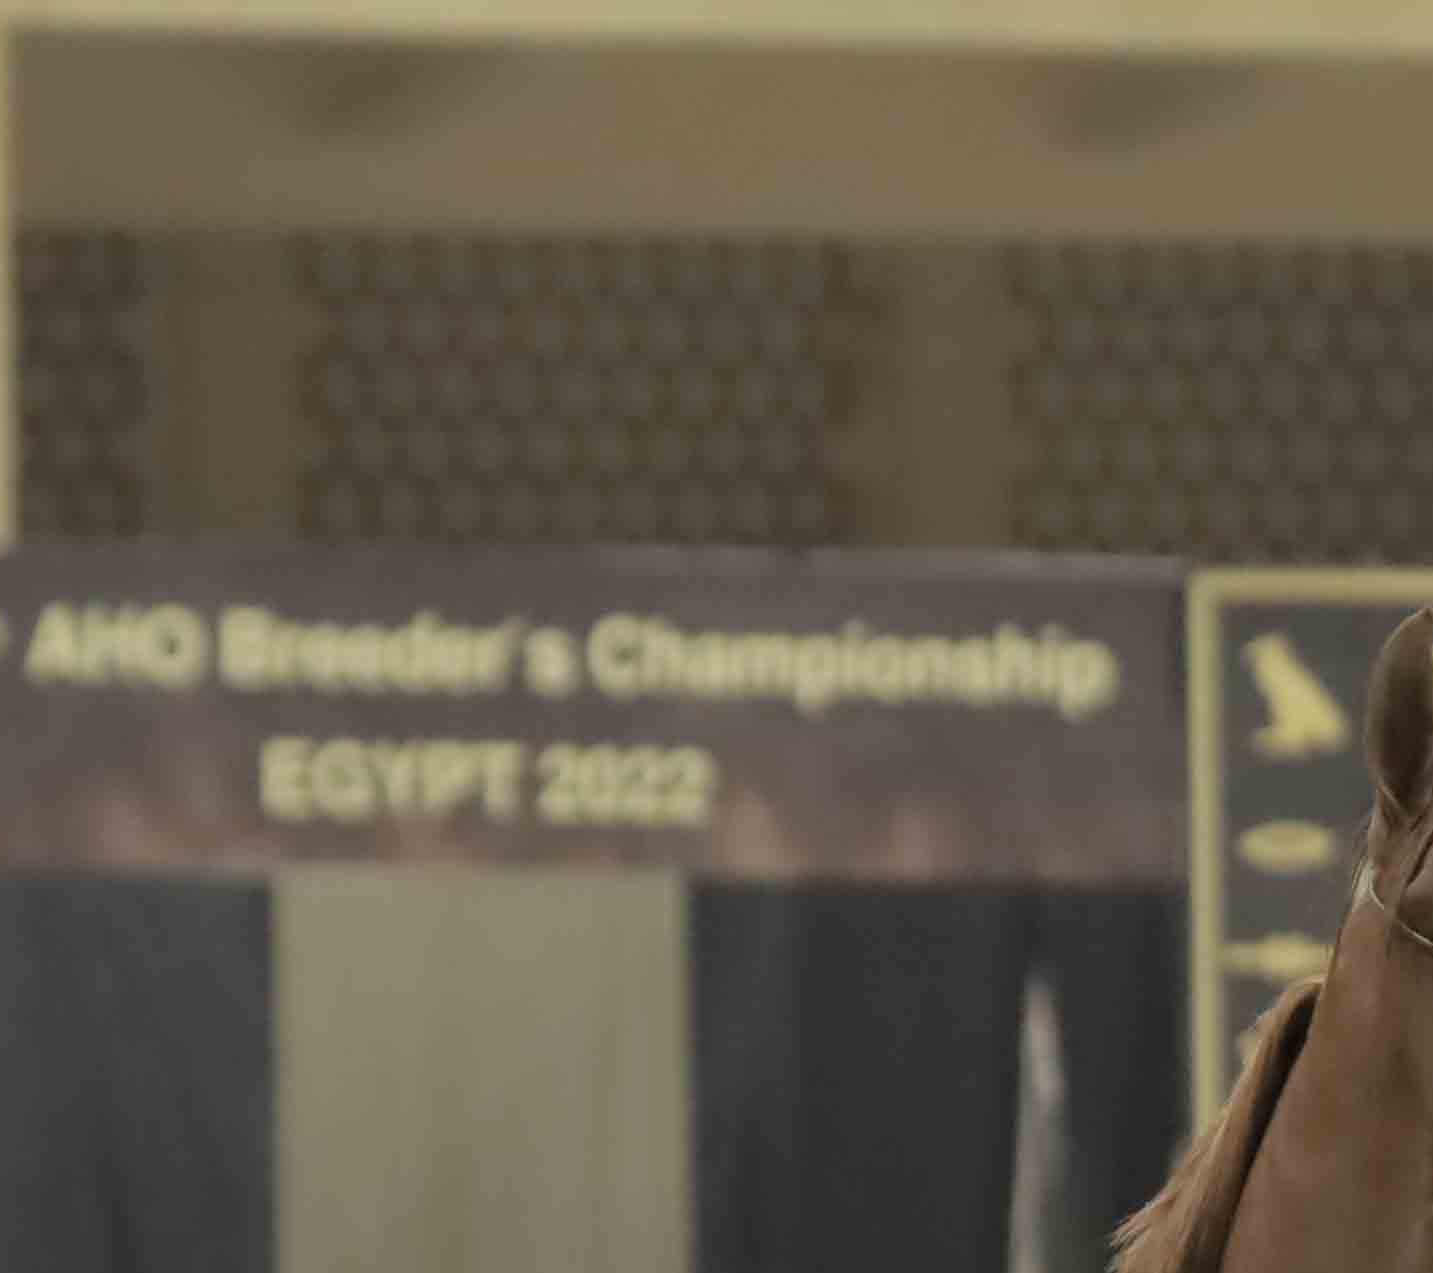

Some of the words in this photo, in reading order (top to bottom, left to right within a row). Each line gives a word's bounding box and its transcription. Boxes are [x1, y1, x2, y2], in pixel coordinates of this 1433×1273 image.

[25, 600, 208, 688] AHO
[586, 612, 1118, 720] Championship
[259, 736, 523, 824] EGYPT
[536, 742, 717, 828] 2022
